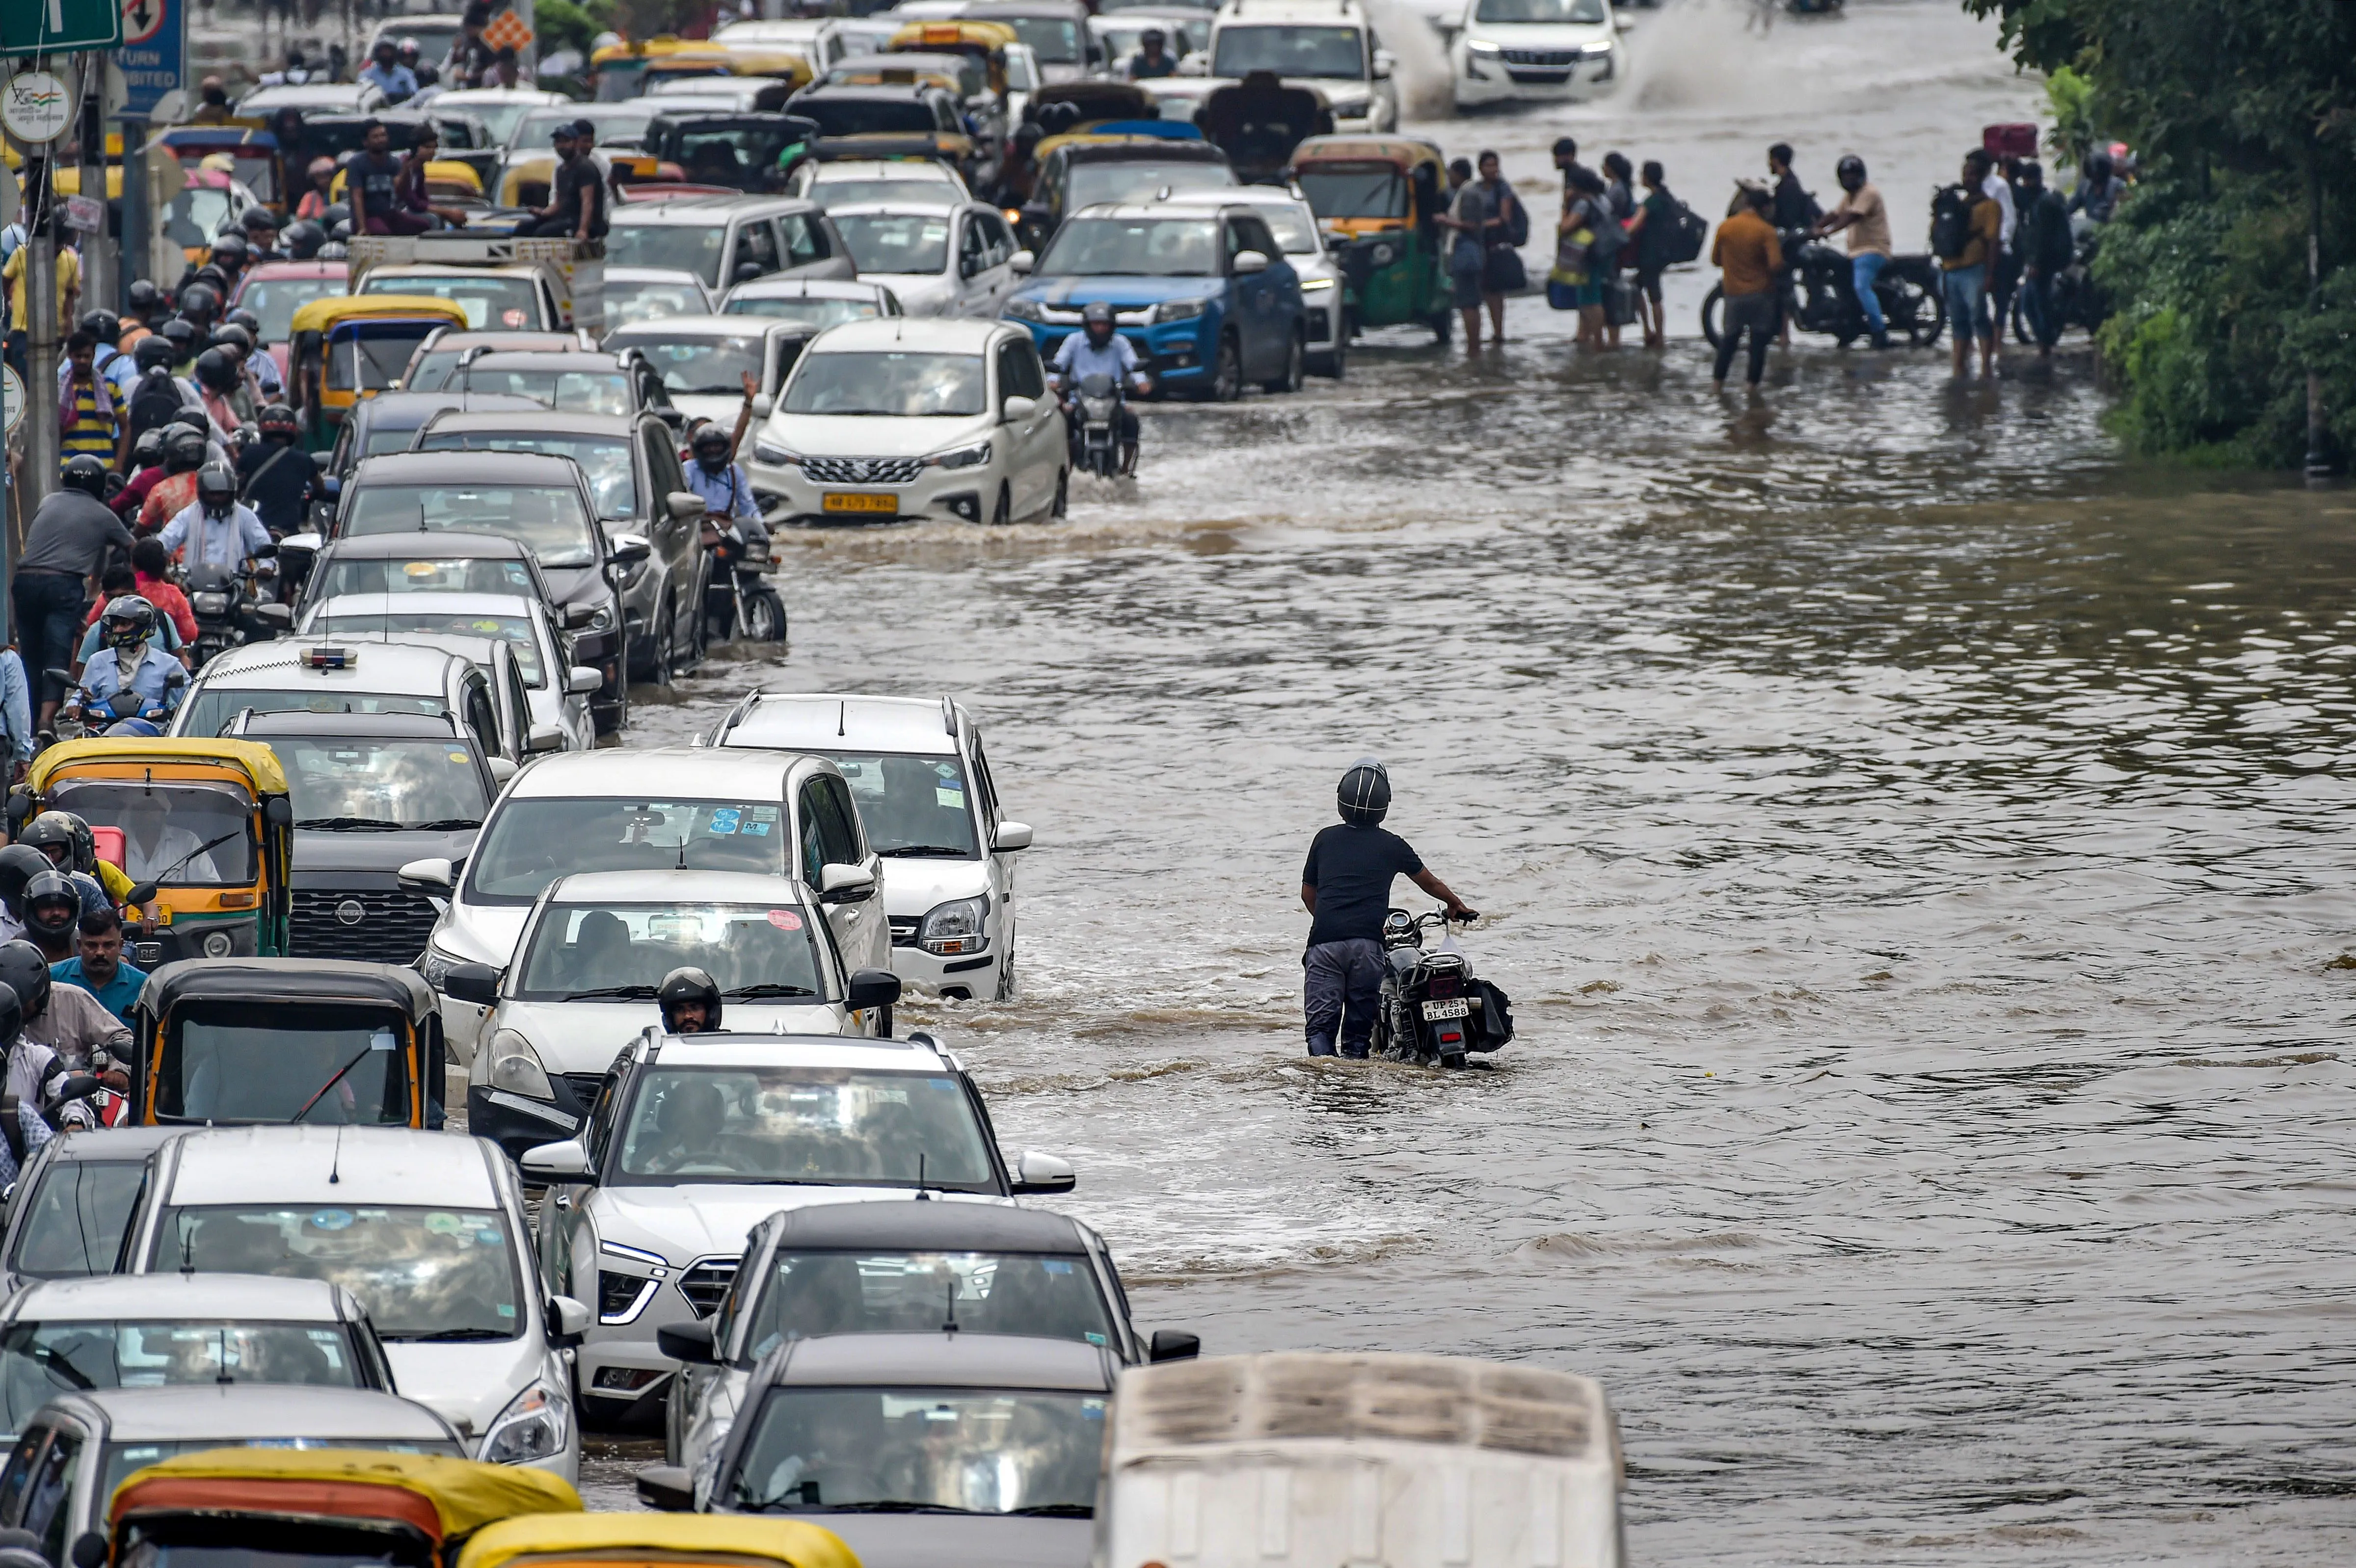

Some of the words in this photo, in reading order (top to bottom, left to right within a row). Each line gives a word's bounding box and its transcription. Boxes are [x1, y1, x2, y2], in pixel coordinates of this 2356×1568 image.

[140, 949, 156, 958] RE
[1432, 1001, 1446, 1010] UP
[1448, 1000, 1459, 1008] 25
[1426, 1011, 1440, 1020] BL
[1442, 1008, 1467, 1017] 4588
